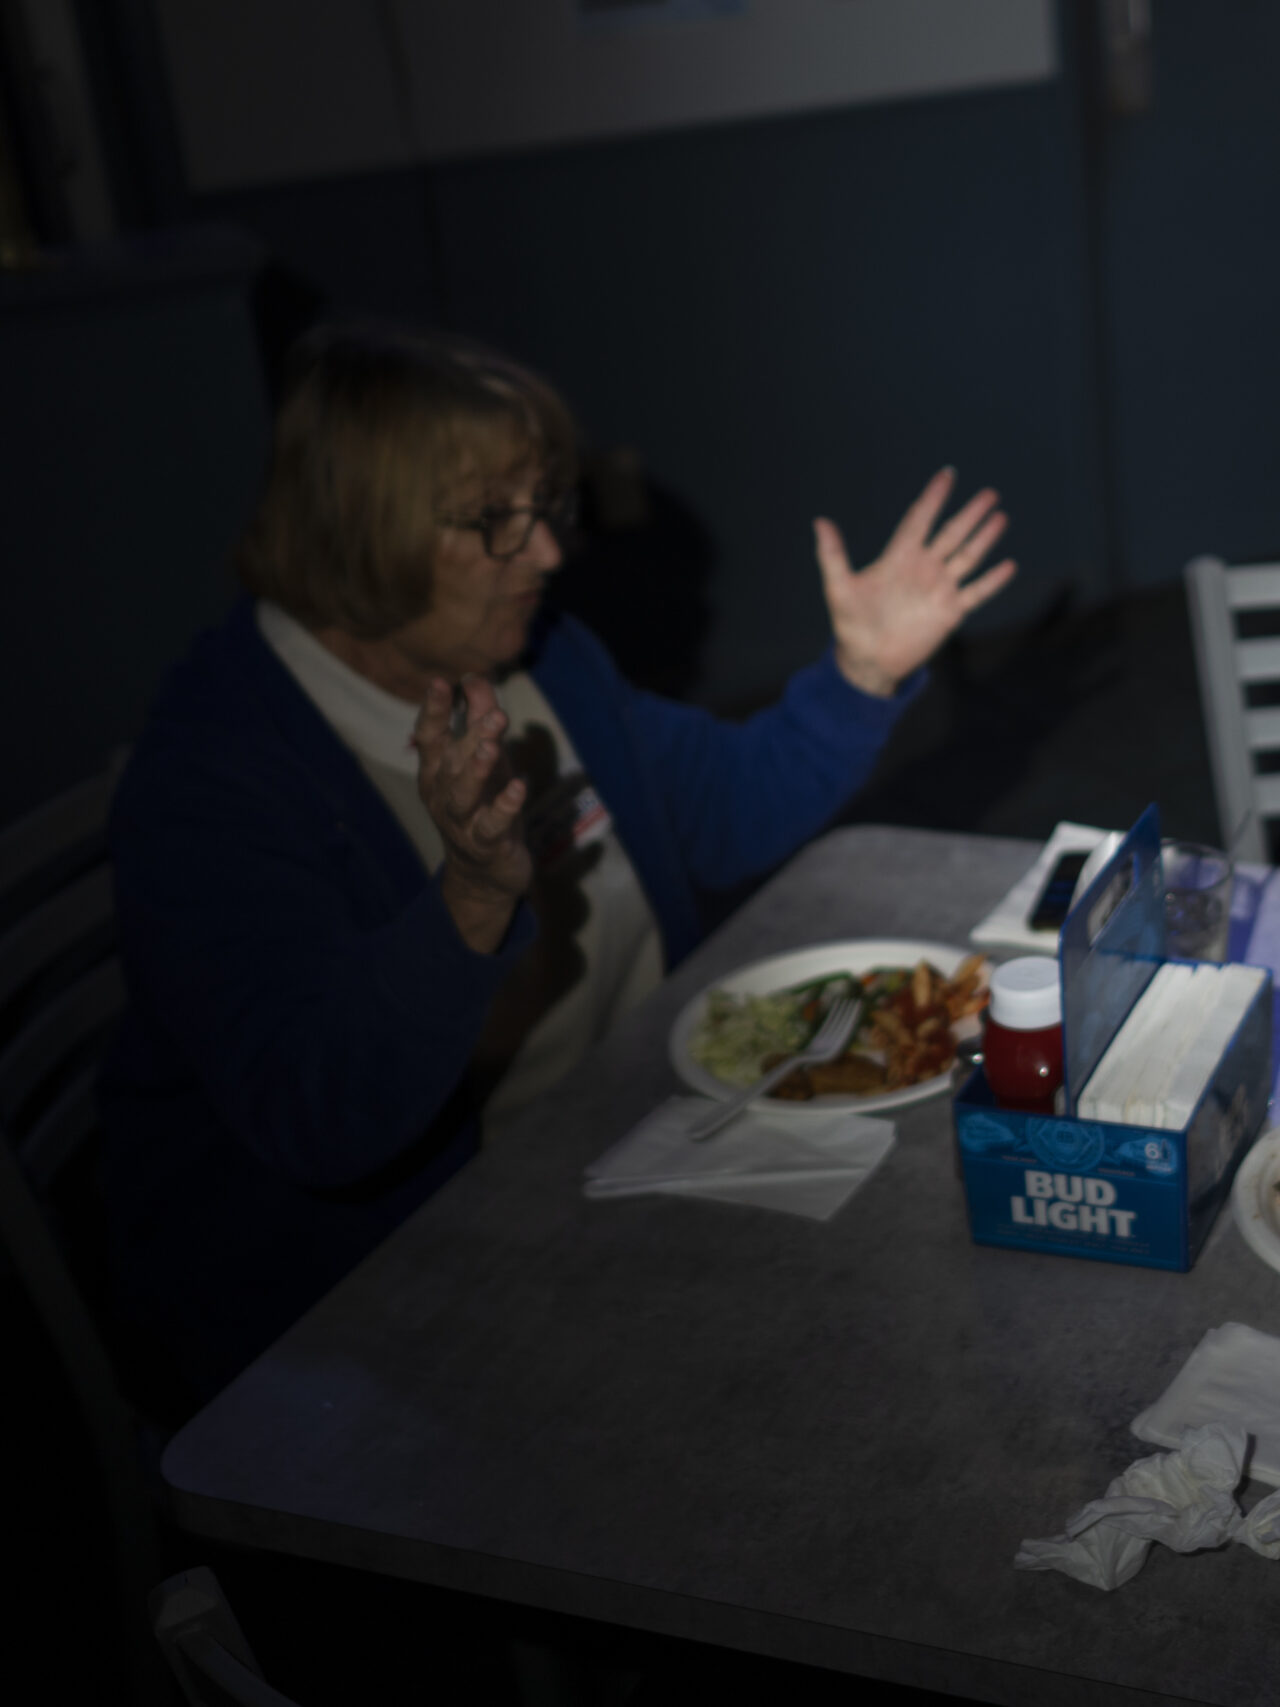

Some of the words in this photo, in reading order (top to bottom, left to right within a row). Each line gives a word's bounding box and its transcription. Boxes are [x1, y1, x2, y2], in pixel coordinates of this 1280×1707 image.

[1144, 1142, 1160, 1160] 6
[1024, 1169, 1118, 1207] BUD
[1010, 1195, 1138, 1238] LIGHT
